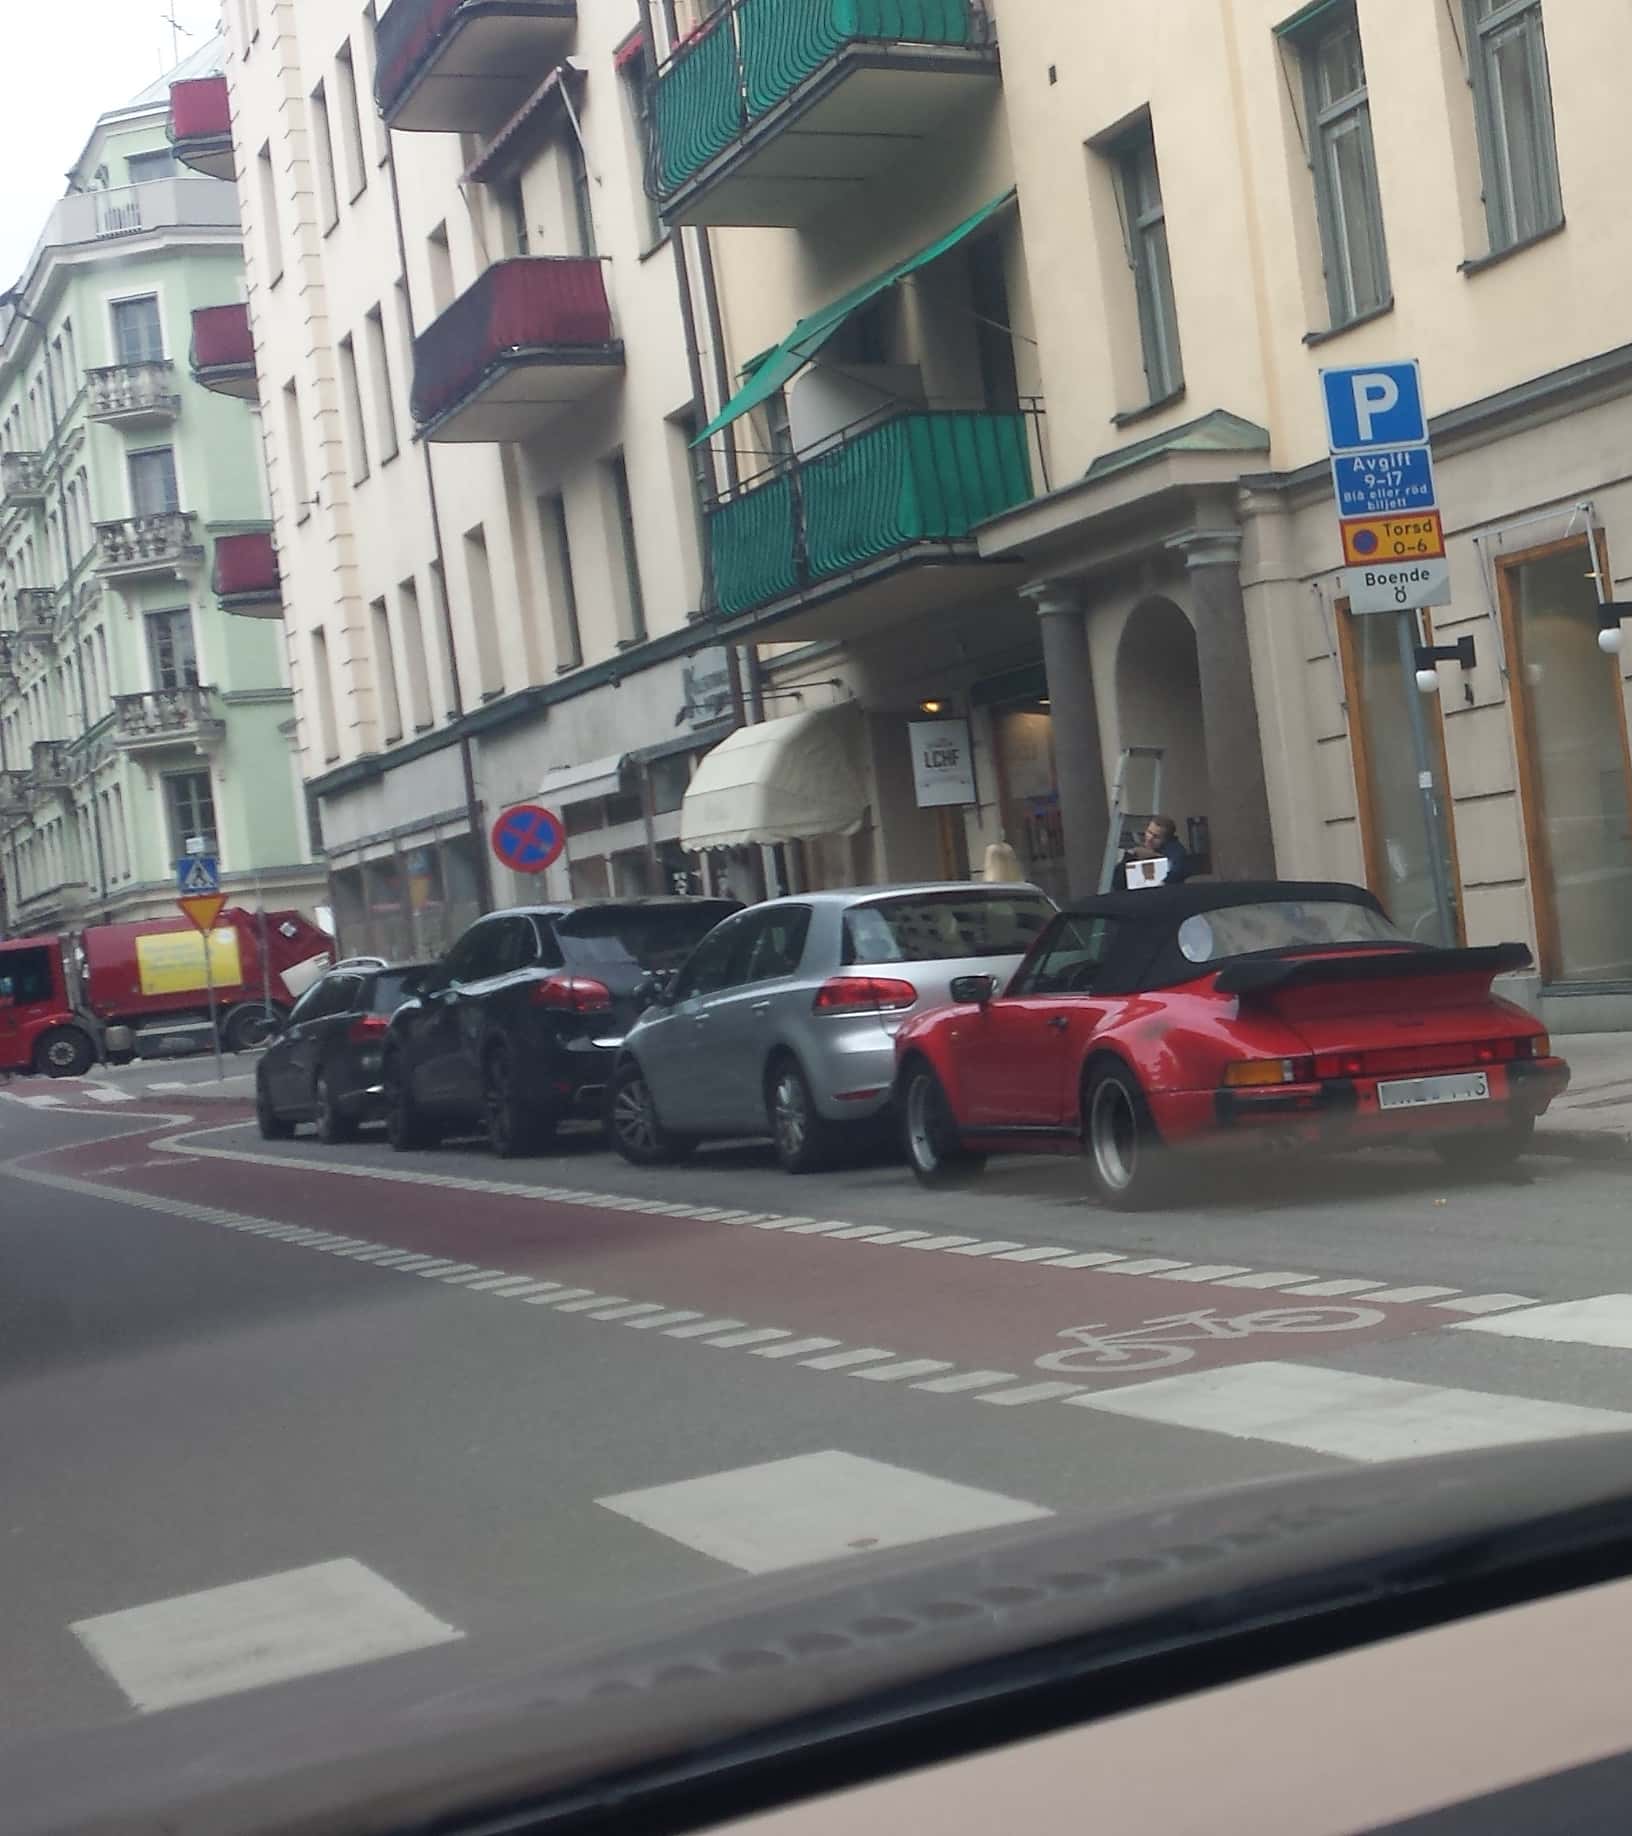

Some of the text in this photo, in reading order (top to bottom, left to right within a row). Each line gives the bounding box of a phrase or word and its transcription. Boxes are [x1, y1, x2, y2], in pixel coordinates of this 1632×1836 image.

[1352, 372, 1399, 441] P
[1352, 451, 1411, 473] Avgift
[1364, 471, 1402, 488] 9-17
[1369, 487, 1400, 500] eller
[1405, 484, 1428, 496] röd
[1367, 497, 1407, 511] biljett
[1384, 519, 1433, 538] Torsd
[1393, 538, 1428, 555] 0-6
[1365, 567, 1430, 587] Boende
[1394, 586, 1407, 604] Ö
[923, 748, 961, 769] LCHF
